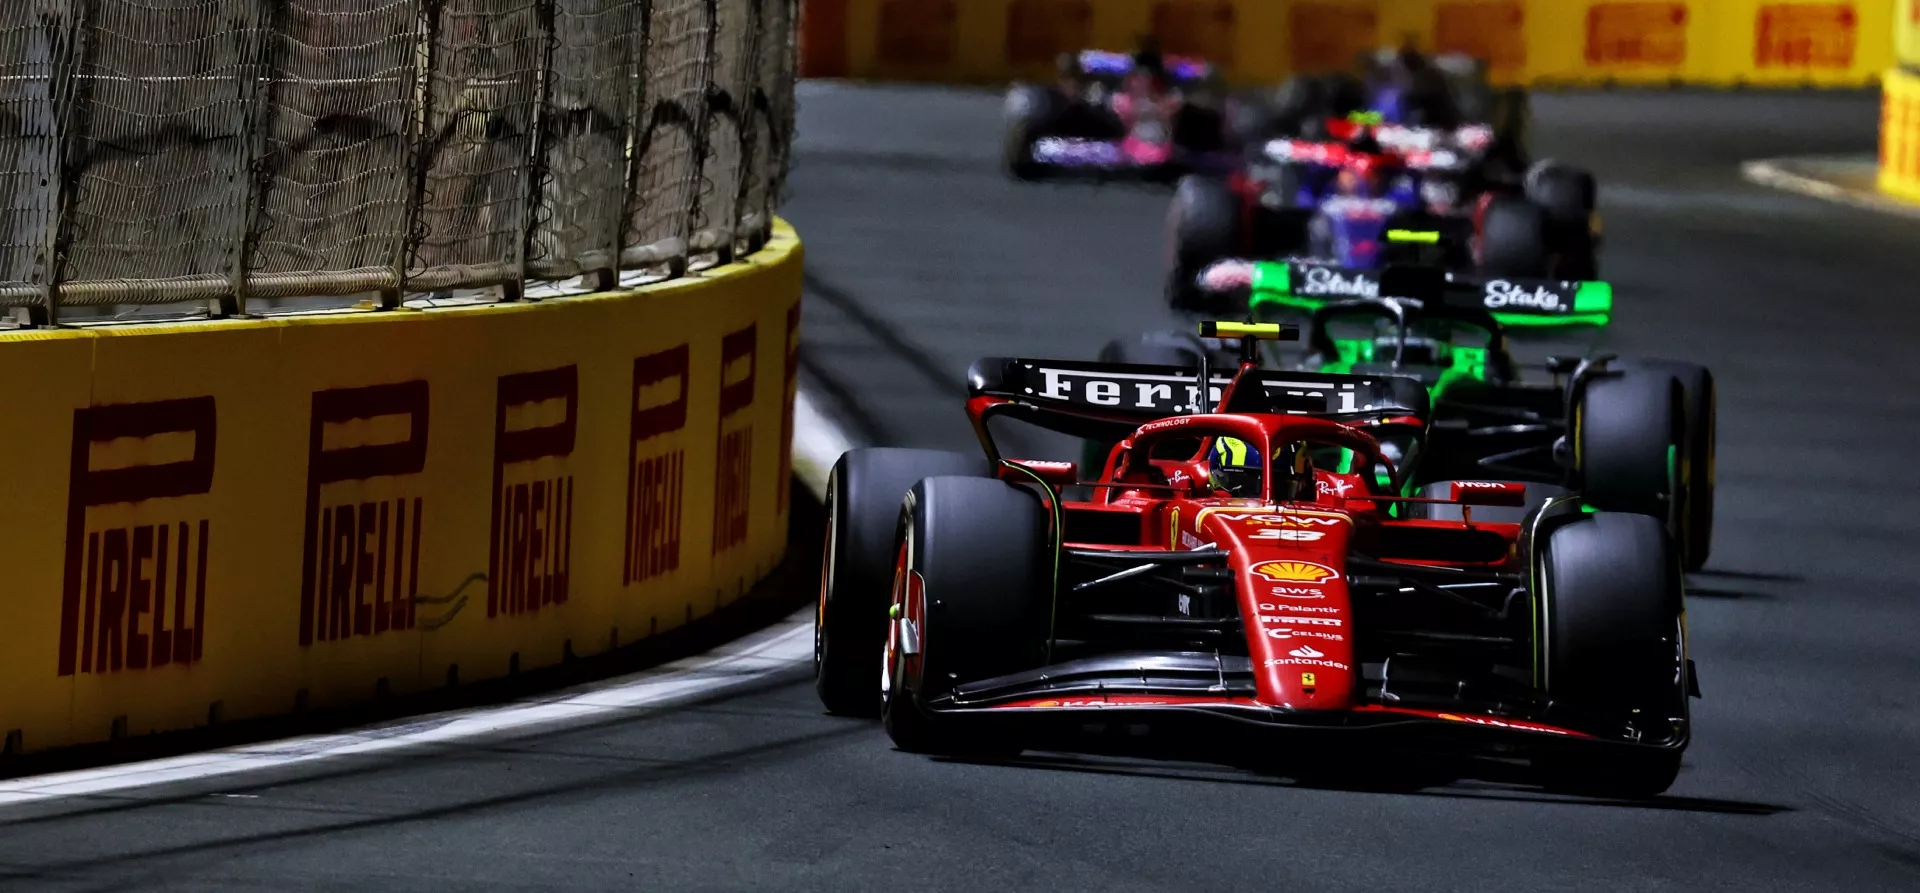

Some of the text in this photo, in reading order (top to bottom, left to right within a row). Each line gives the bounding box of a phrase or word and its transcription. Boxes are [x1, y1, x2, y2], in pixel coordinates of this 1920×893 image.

[1483, 278, 1559, 311] Stake
[1038, 367, 1360, 415] Ferri
[1145, 417, 1191, 430] TECHNOLOGY
[622, 343, 690, 587] PIRELLI
[486, 363, 579, 619] PIRELLI
[1315, 479, 1354, 496] Ray-Ban
[298, 379, 430, 647] PIRELLI
[57, 394, 217, 677] PIRELLI
[1271, 586, 1323, 596] aws
[1260, 615, 1343, 627] PIRELLI
[1278, 604, 1341, 614] Palantir
[1264, 657, 1350, 671] Santander
